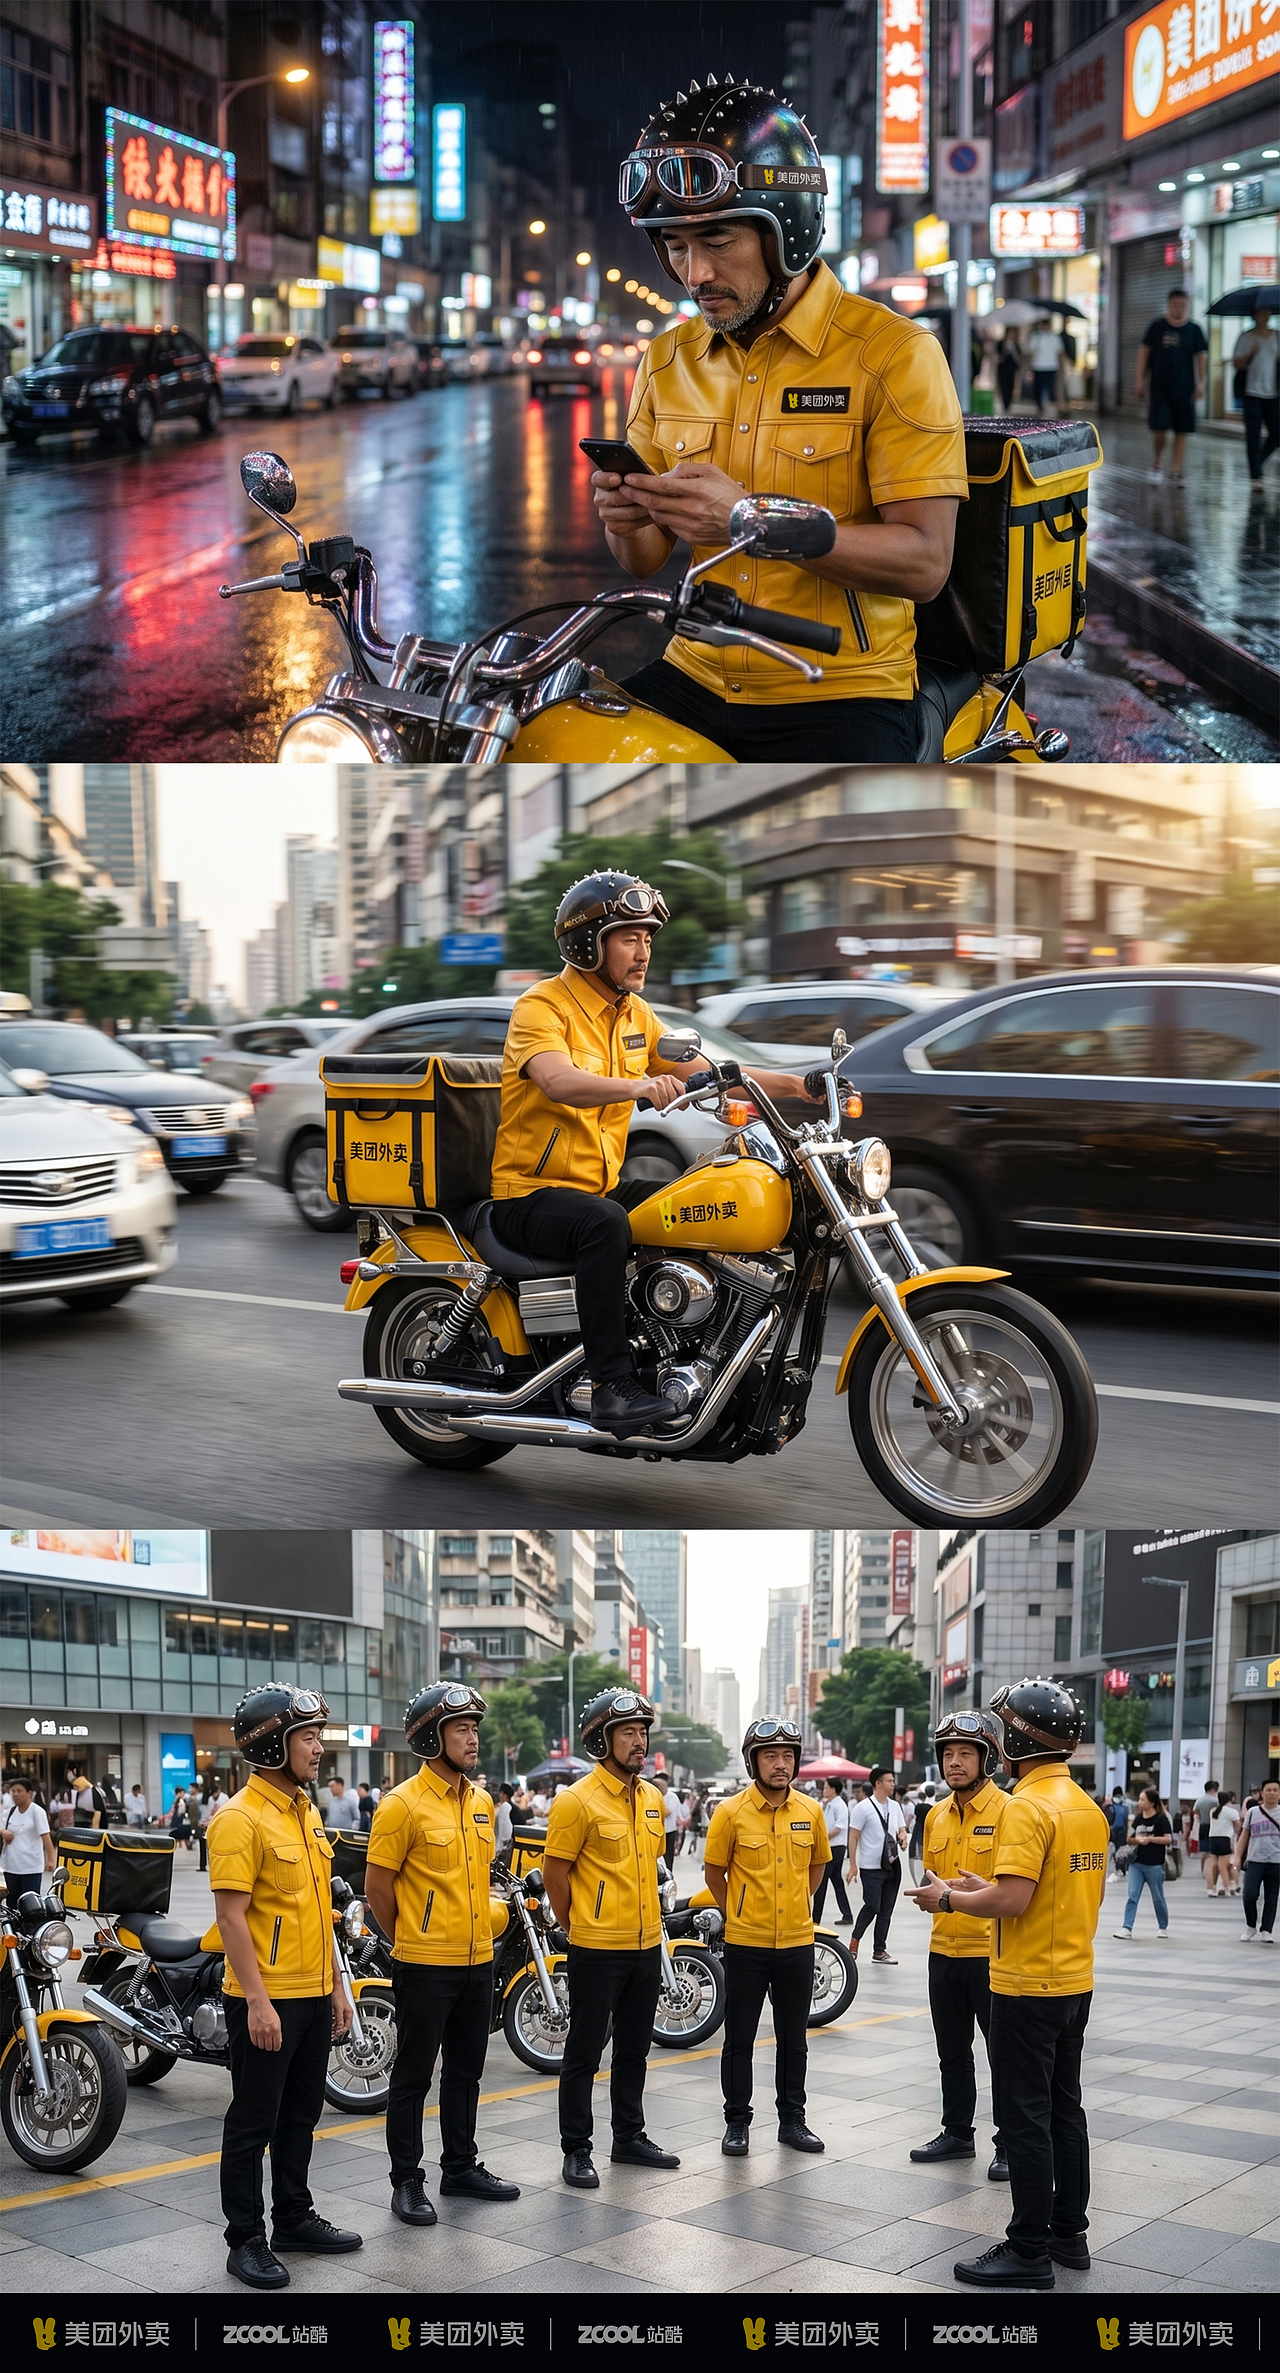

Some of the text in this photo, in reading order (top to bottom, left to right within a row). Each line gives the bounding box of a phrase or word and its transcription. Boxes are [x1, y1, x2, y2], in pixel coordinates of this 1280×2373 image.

[777, 171, 821, 186] 美团外卖
[801, 394, 845, 407] 美团外卖
[350, 1141, 408, 1163] 美团外卖
[680, 1201, 738, 1224] 美团外卖
